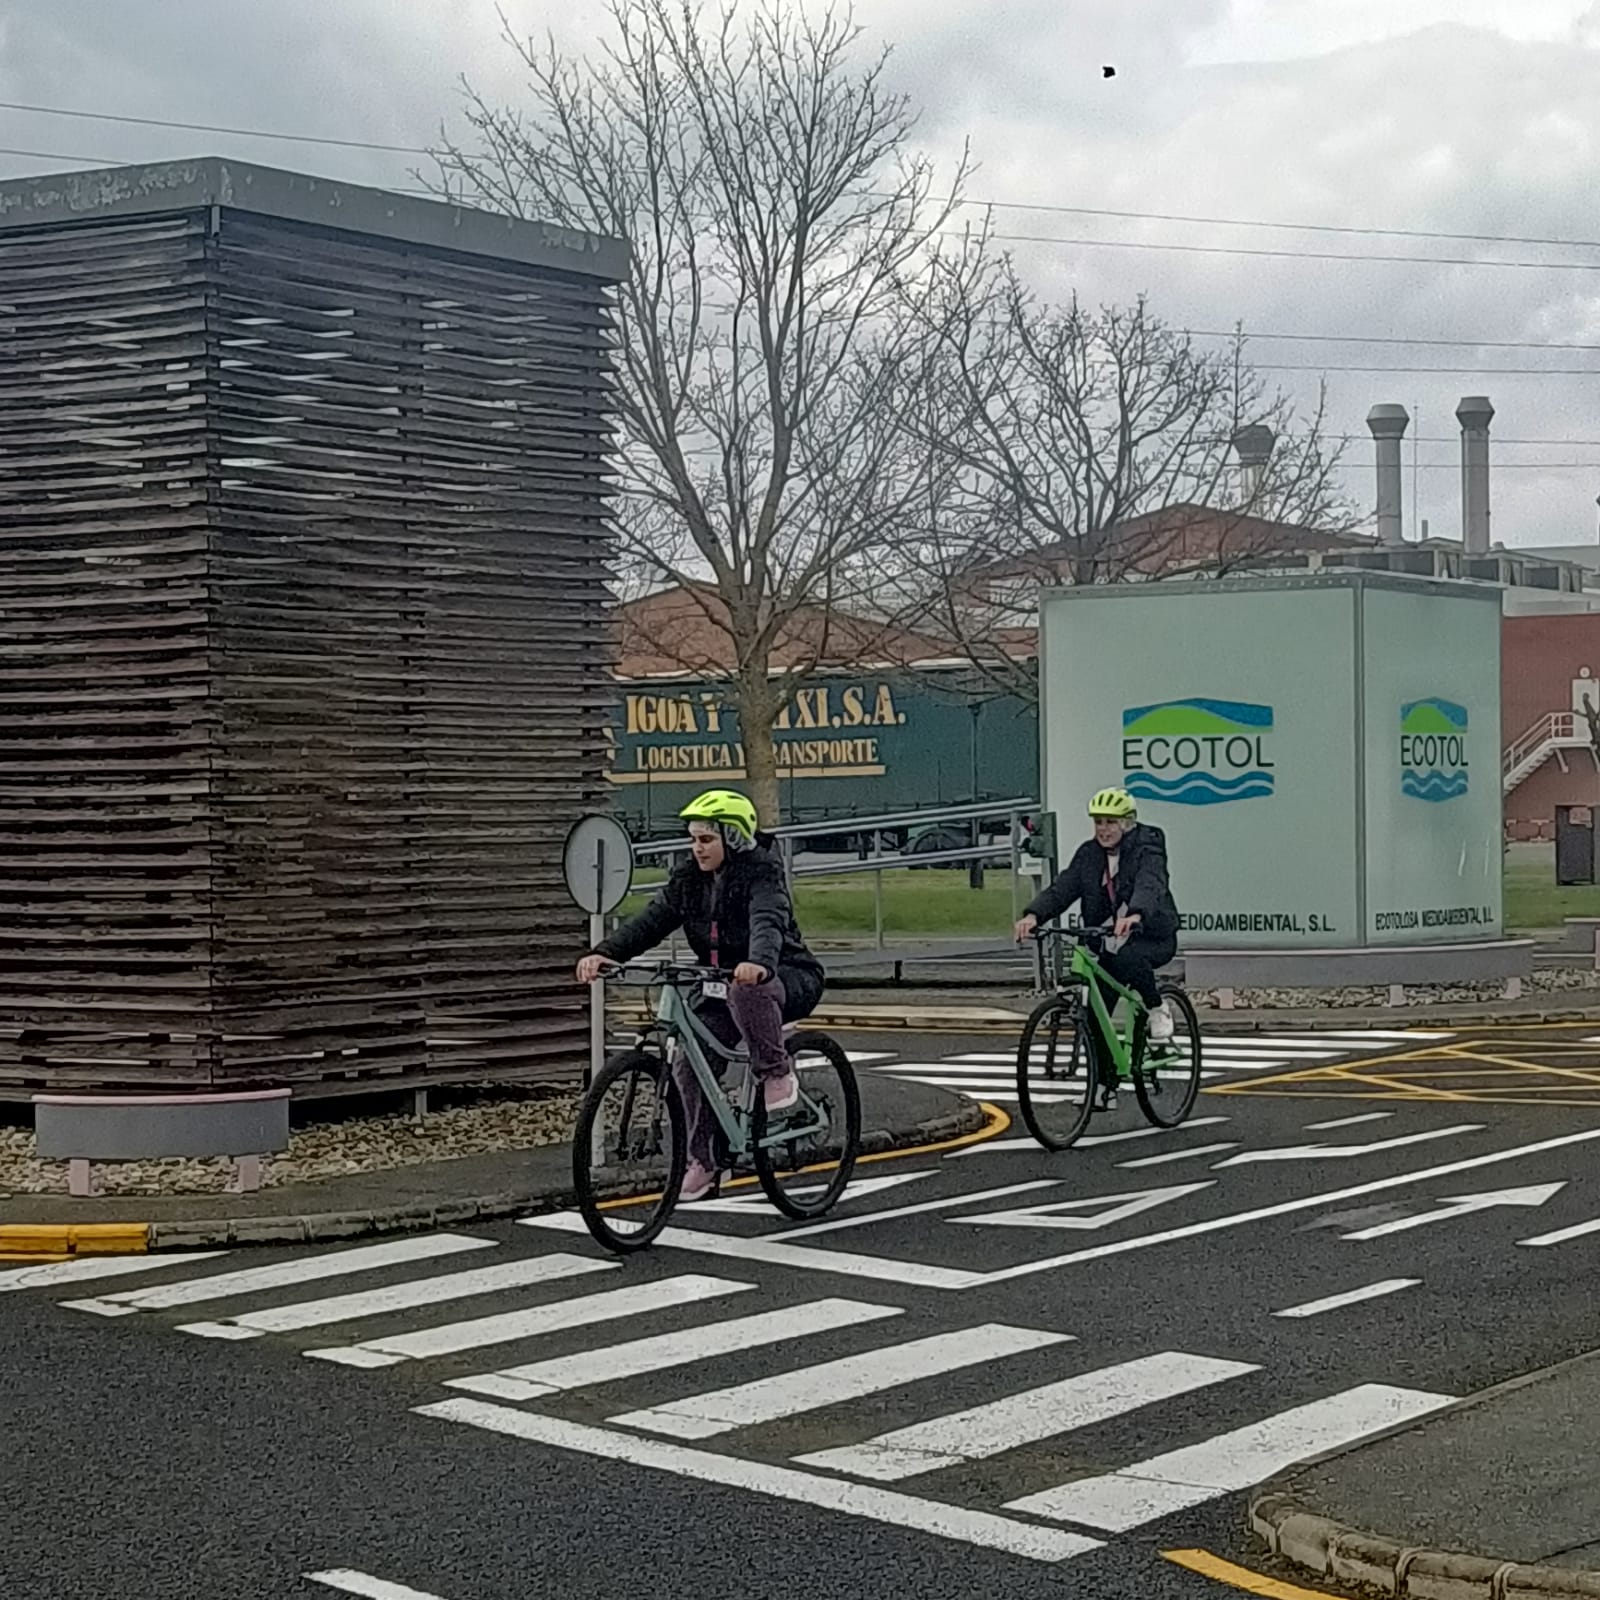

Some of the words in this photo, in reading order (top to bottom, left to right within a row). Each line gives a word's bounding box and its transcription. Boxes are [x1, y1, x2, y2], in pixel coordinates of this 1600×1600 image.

[626, 694, 698, 734] IGOA
[700, 692, 724, 732] Y
[636, 743, 732, 770] LOGISTICA
[771, 738, 879, 766] RANSPORTE
[1122, 736, 1275, 770] ECOTOL
[1400, 734, 1469, 767] ECOTOL
[1177, 913, 1305, 935] EDIOAMBIENTAL,
[1308, 913, 1336, 932] S.L.
